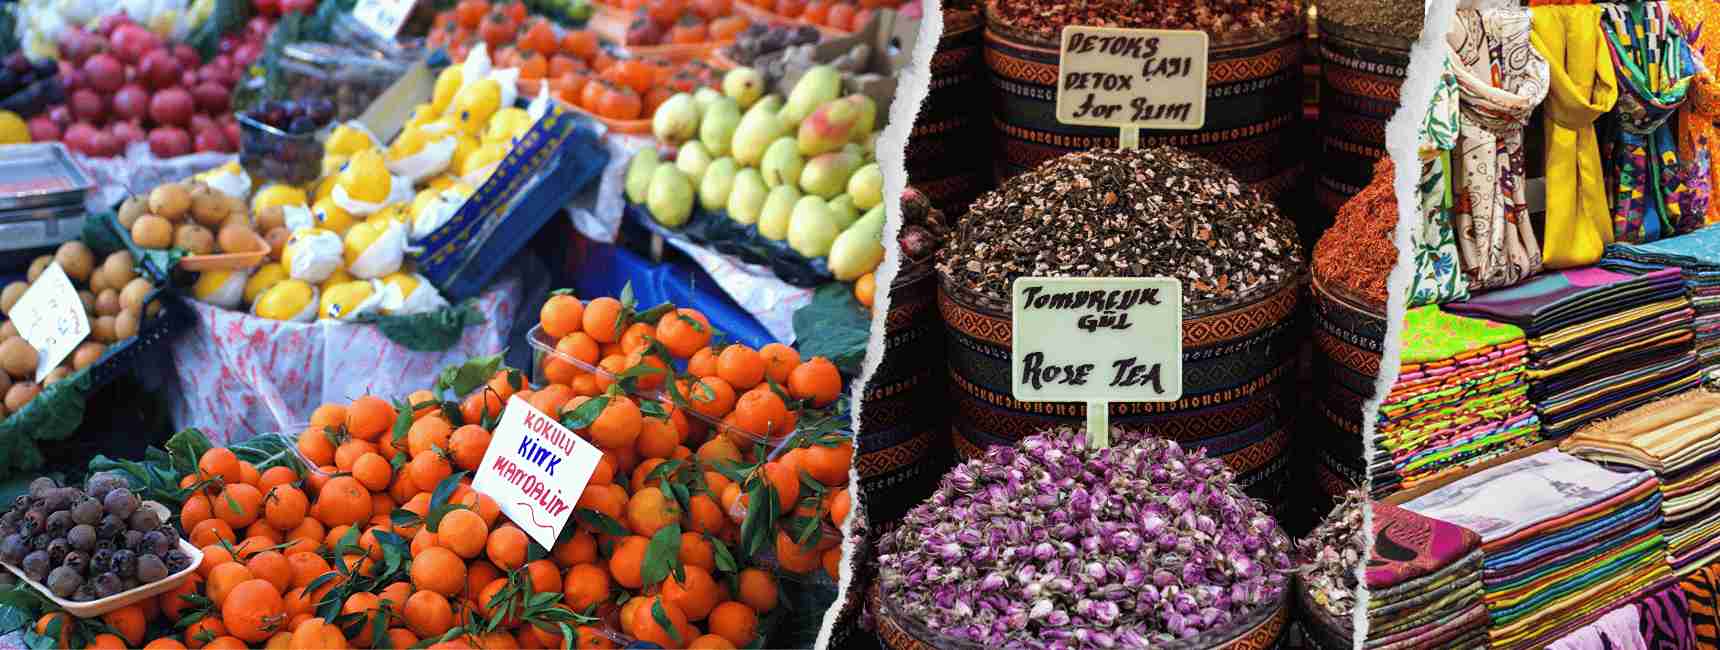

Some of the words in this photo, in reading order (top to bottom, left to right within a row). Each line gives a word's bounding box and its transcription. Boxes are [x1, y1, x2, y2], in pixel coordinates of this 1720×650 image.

[1066, 32, 1160, 59] DETOKS
[1064, 72, 1133, 91] DETOX
[1109, 357, 1165, 394] TEA
[524, 410, 576, 456] KOKULU
